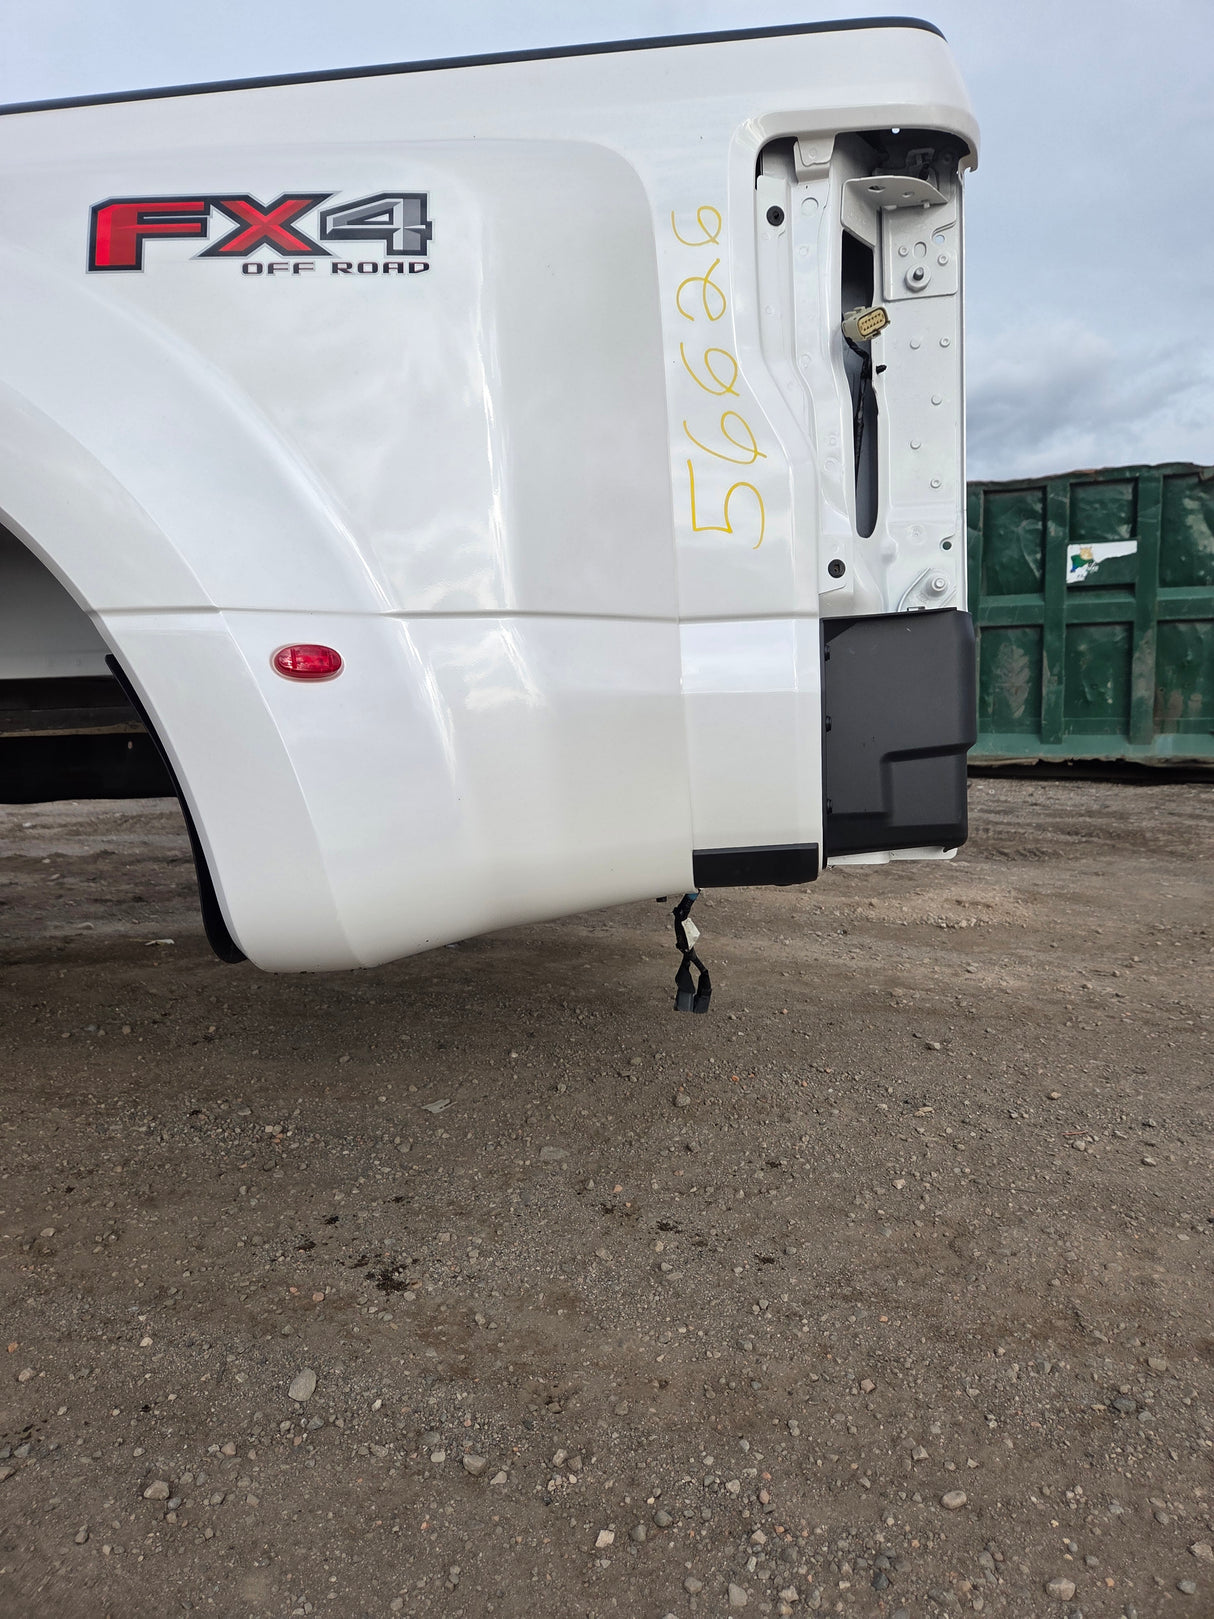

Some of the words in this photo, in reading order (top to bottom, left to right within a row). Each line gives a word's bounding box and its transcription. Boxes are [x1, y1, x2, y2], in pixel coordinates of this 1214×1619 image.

[87, 191, 433, 272] FX4
[241, 261, 316, 275] OFF
[331, 261, 431, 275] ROAD
[671, 205, 767, 550] 56626
